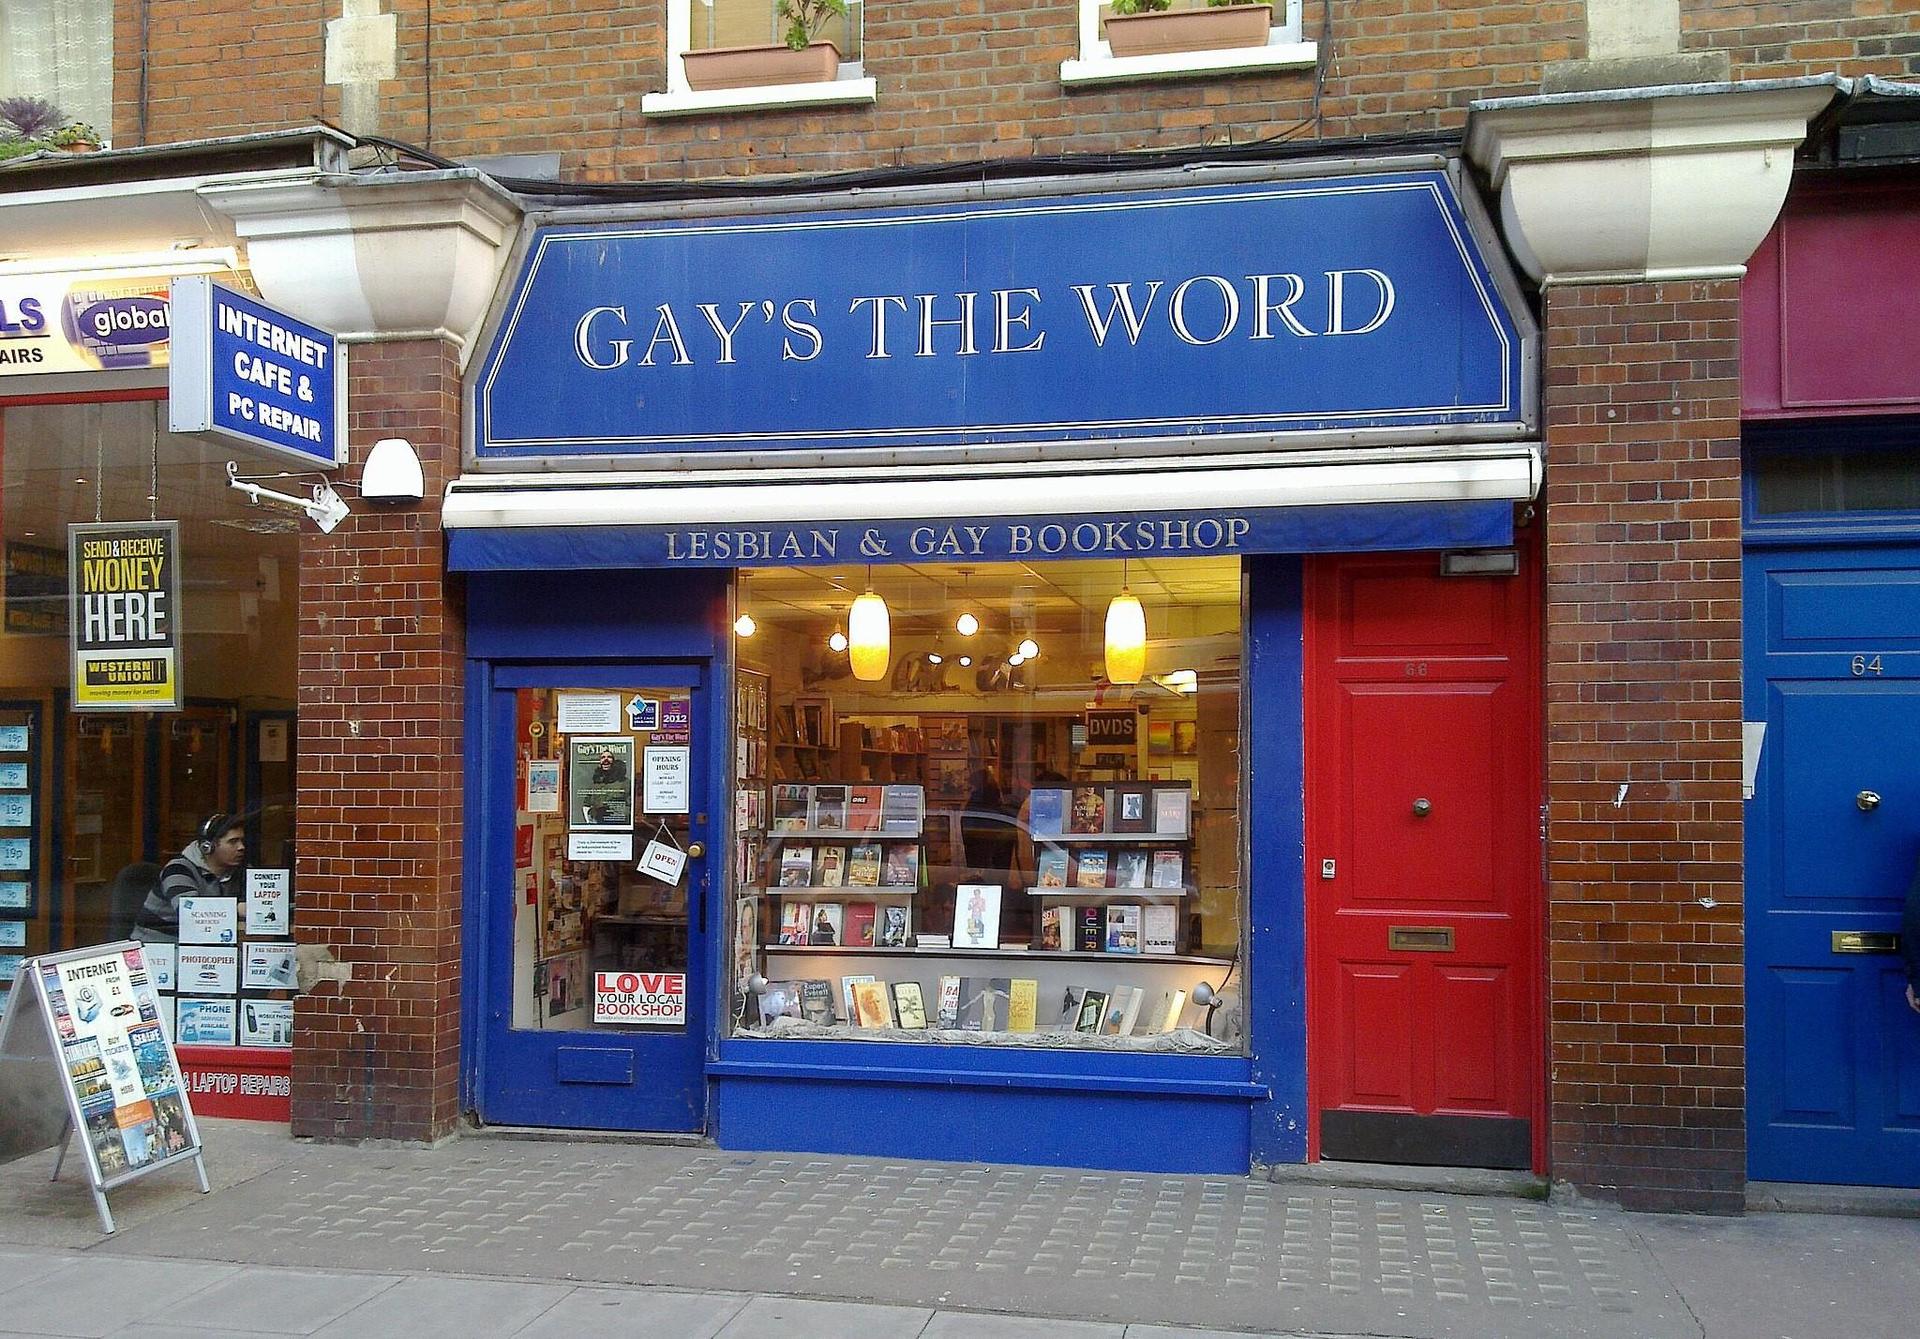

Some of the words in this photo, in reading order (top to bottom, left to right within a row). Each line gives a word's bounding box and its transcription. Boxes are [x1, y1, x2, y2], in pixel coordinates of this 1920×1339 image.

[94, 304, 170, 336] global
[574, 298, 823, 370] GAY'S
[849, 288, 1046, 358] THE
[1070, 268, 1396, 347] WORD
[218, 303, 328, 369] INTERNET
[234, 352, 292, 396] CAFE
[297, 375, 314, 403] &
[229, 393, 255, 420] PC
[258, 402, 321, 442] REPAIR
[665, 528, 839, 559] LESBIAN
[859, 528, 892, 556] &
[909, 525, 990, 555] GAY
[1008, 518, 1250, 553] BOOKSHOP
[84, 538, 164, 558] SEND&RECEIVE
[84, 557, 164, 593] MONEY
[85, 592, 165, 642] HERE
[88, 660, 151, 672] WESTERN
[1852, 655, 1884, 676] 64
[108, 671, 151, 682] UNION
[663, 715, 687, 723] 2012
[1090, 718, 1133, 735] DVDS
[577, 744, 595, 755] Gay's
[596, 744, 608, 753] The
[609, 744, 627, 754] Word
[655, 853, 677, 866] OPEN
[254, 873, 281, 881] CONNECT
[191, 911, 227, 919] SCANNING
[1085, 908, 1097, 949] QUEER
[181, 955, 235, 965] PHOTOCOPIER
[66, 961, 118, 981] INTERNET
[597, 974, 683, 994] LOVE
[804, 982, 826, 990] Rupert
[804, 988, 828, 996] Everett
[597, 993, 636, 1003] YOUR
[640, 994, 683, 1004] LOCAL
[199, 1005, 231, 1013] PHONE
[597, 1003, 682, 1016] BOOKSHOP
[193, 1072, 238, 1094] LAPTOP
[240, 1074, 291, 1097] REPAIRS
